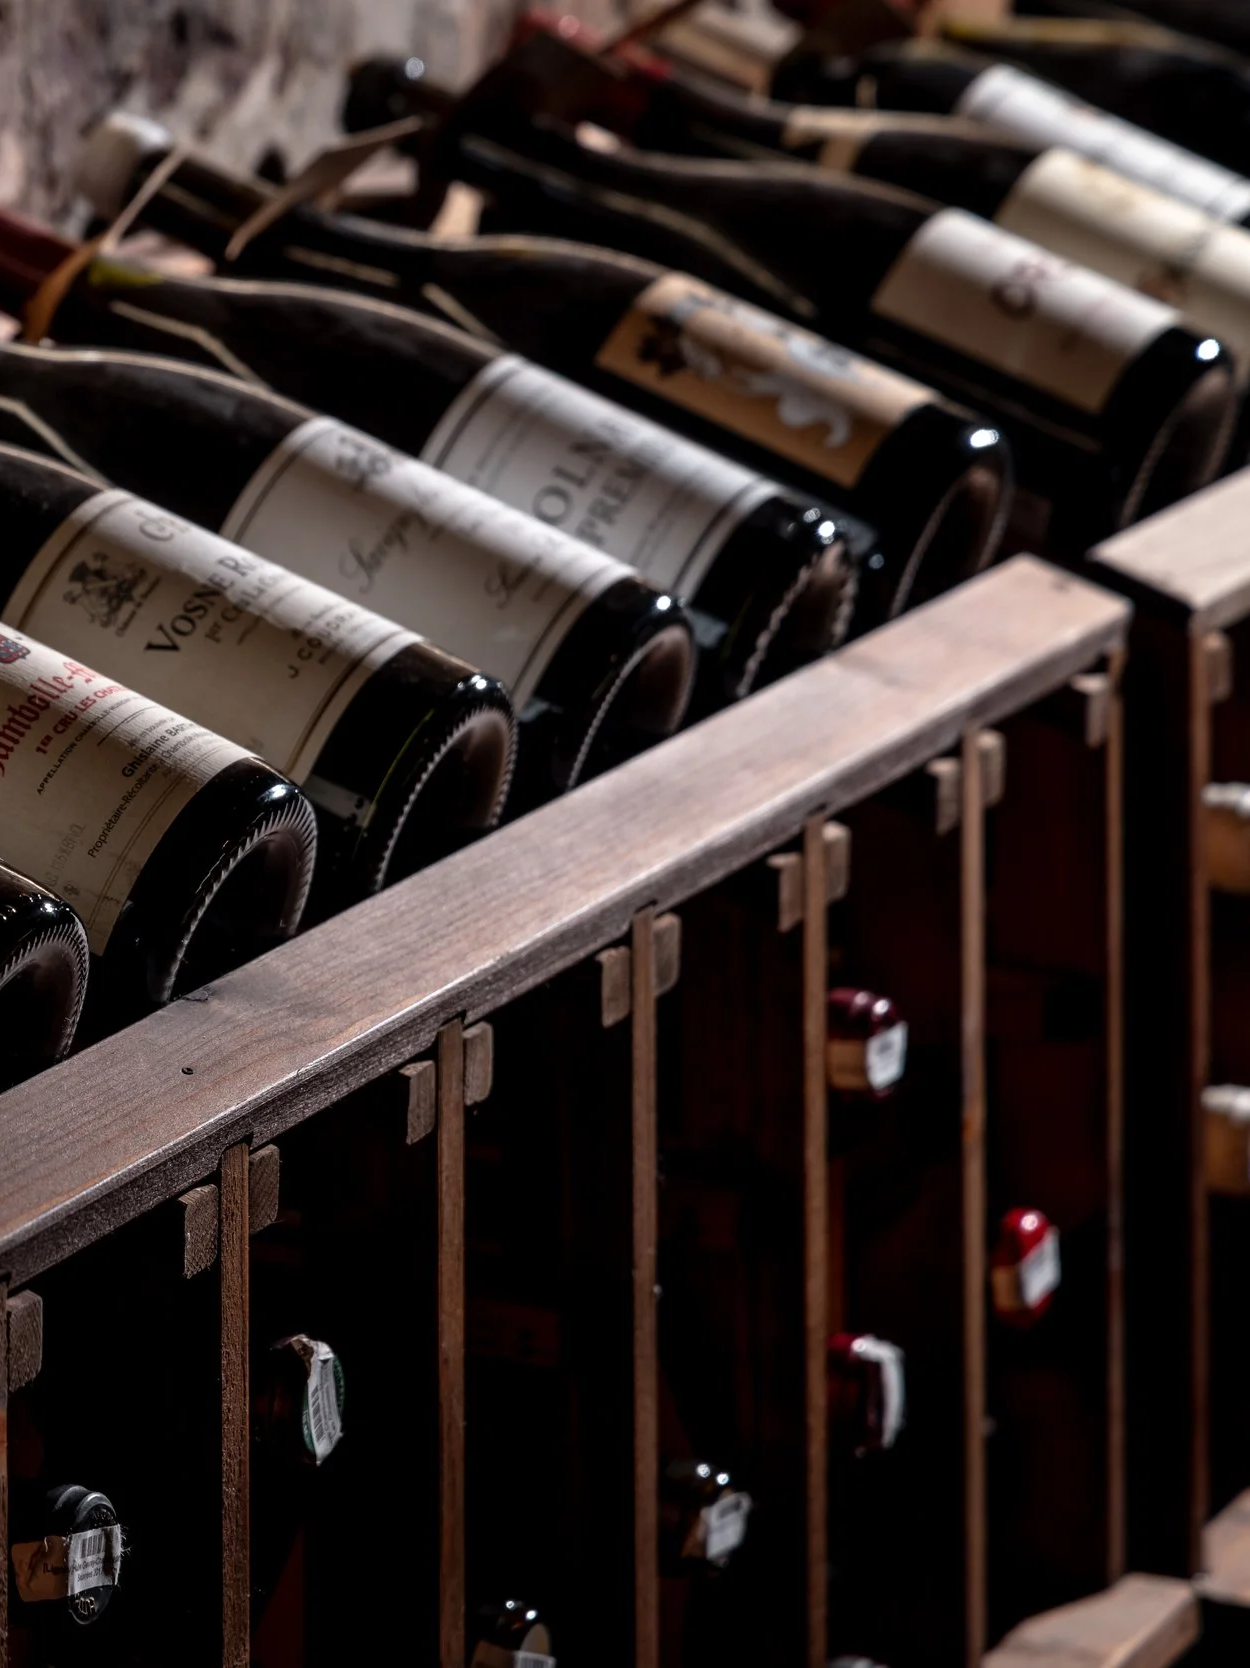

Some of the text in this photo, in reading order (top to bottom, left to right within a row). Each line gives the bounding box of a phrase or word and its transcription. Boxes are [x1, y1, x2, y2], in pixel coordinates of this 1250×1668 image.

[53, 710, 79, 734] CRU
[36, 742, 77, 796] APPELLATION
[121, 735, 170, 778] Ghislaine
